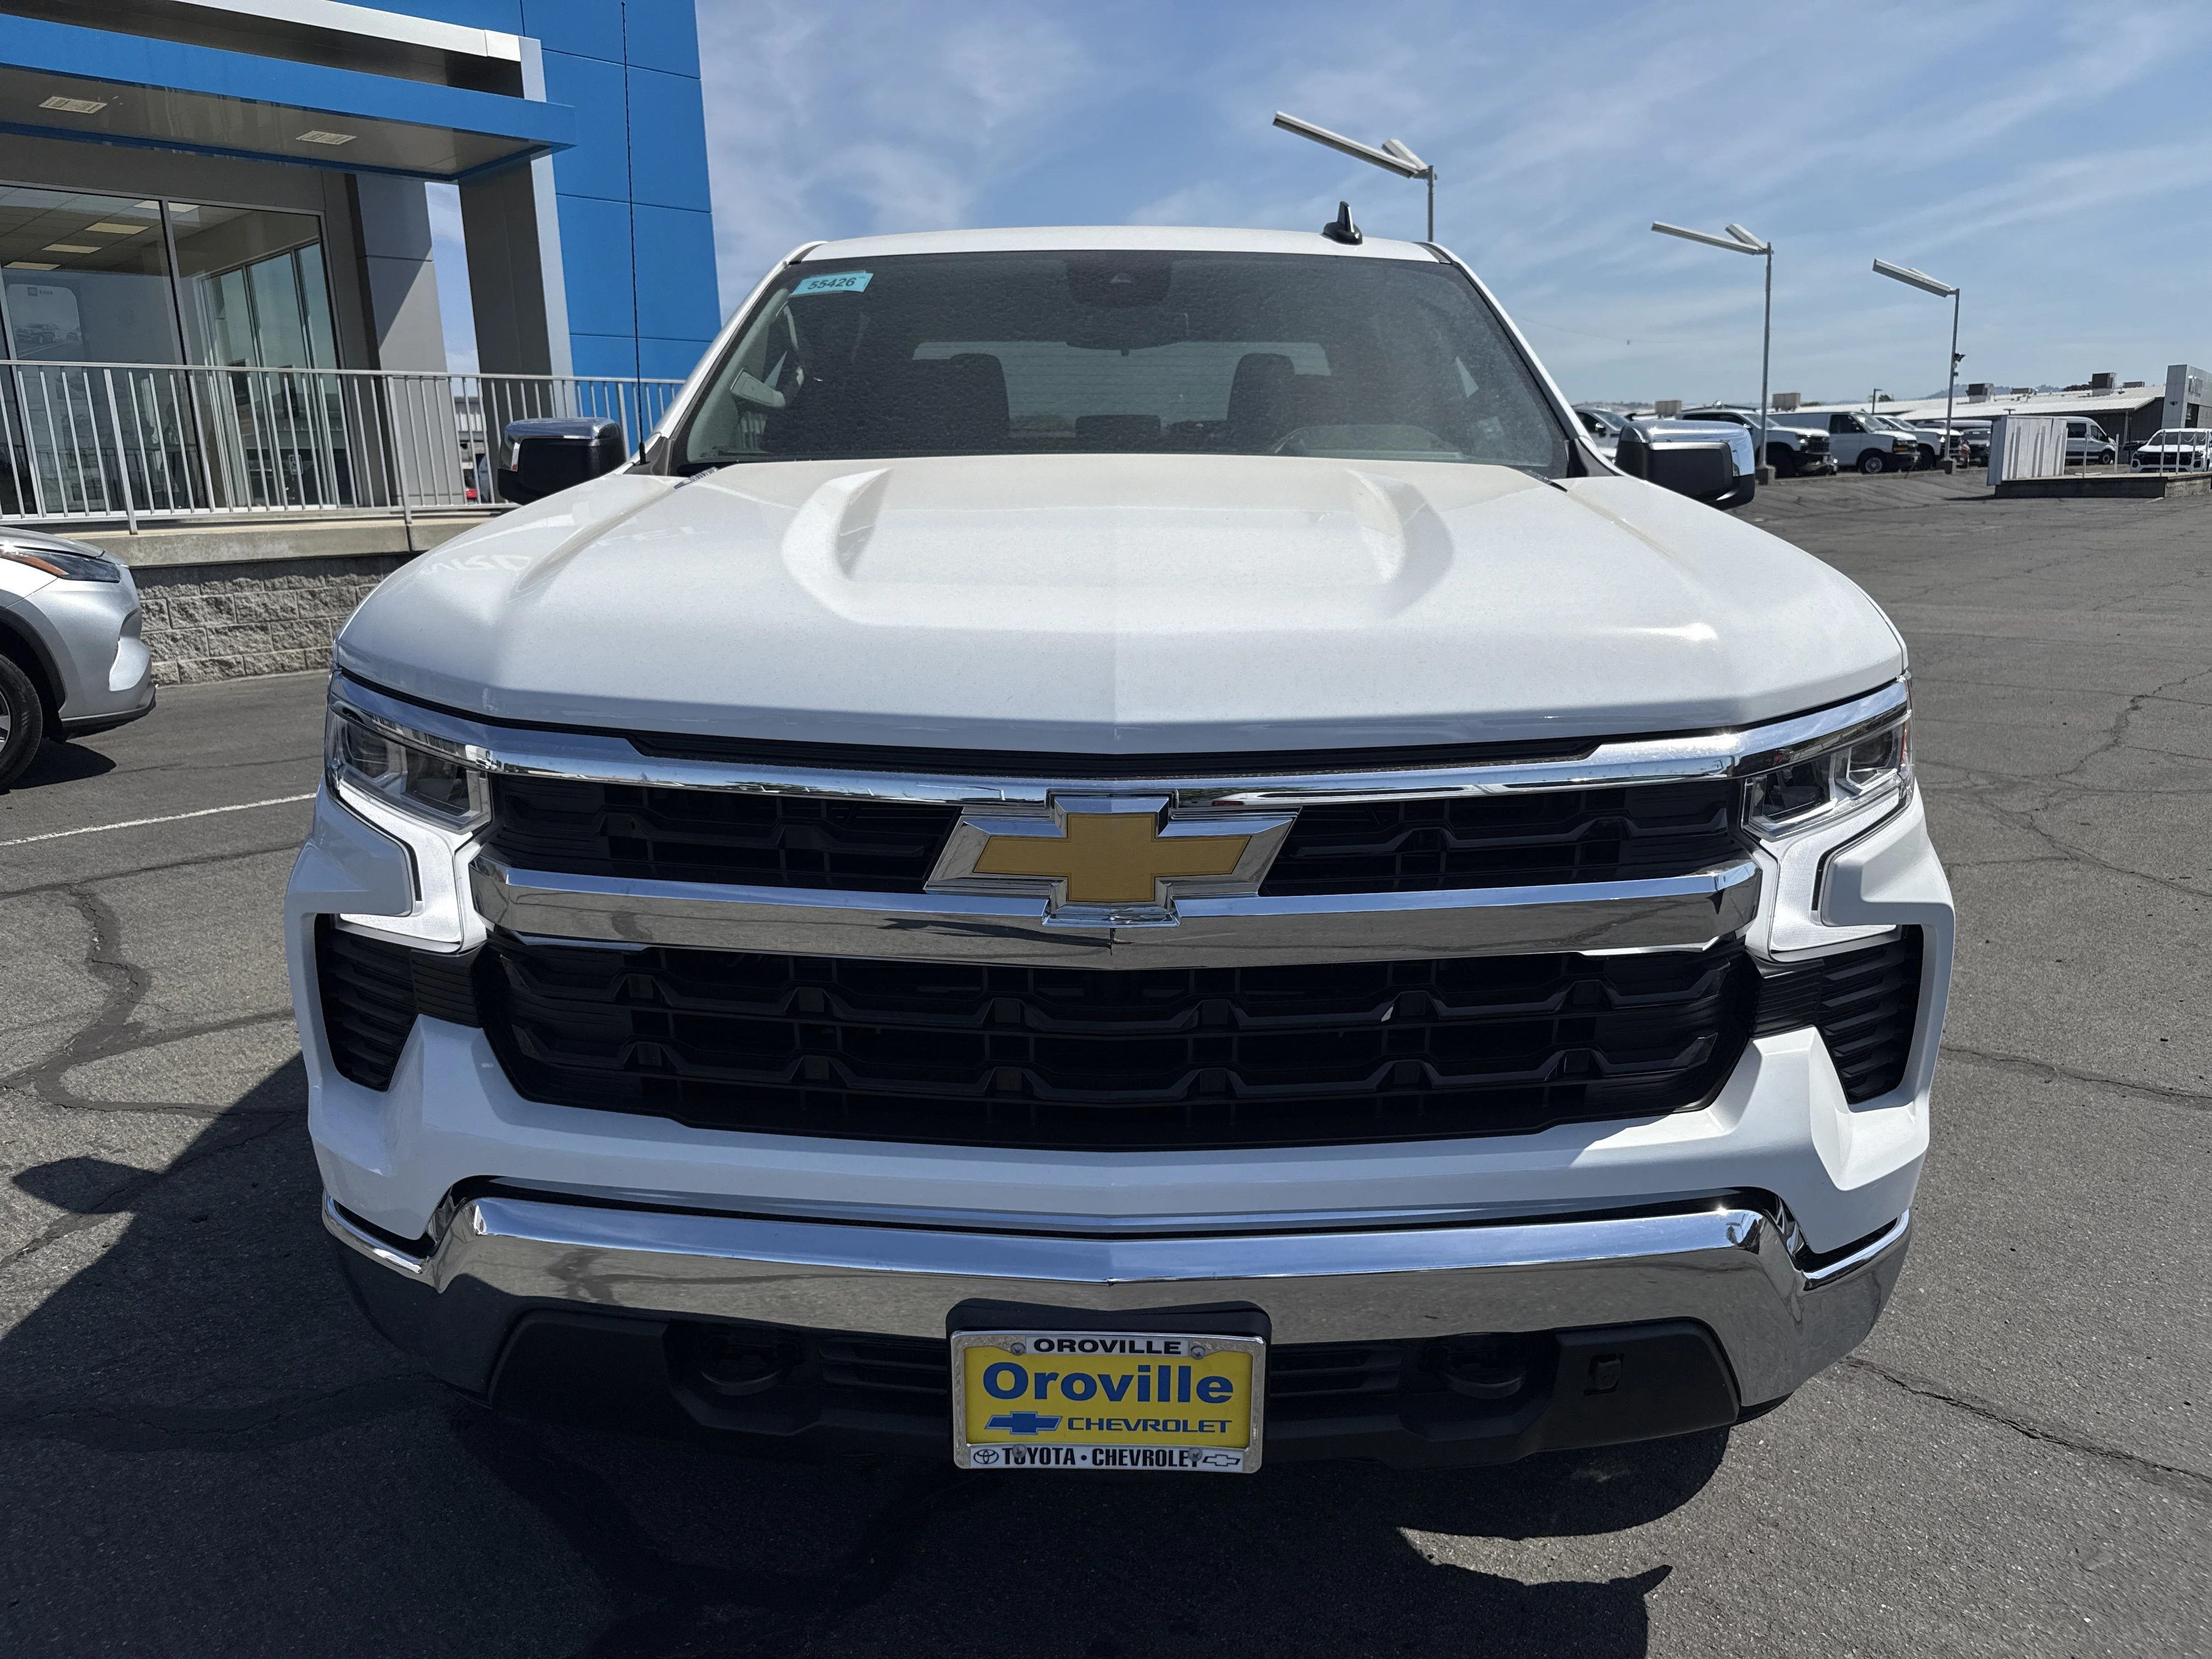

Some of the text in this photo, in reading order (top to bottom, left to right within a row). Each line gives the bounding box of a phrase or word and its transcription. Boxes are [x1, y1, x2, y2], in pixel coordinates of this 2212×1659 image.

[808, 277, 856, 290] 55426
[1034, 1338, 1181, 1355] OROVILLE
[983, 1362, 1234, 1404] Oroville
[1068, 1417, 1233, 1434] CHEVROLET
